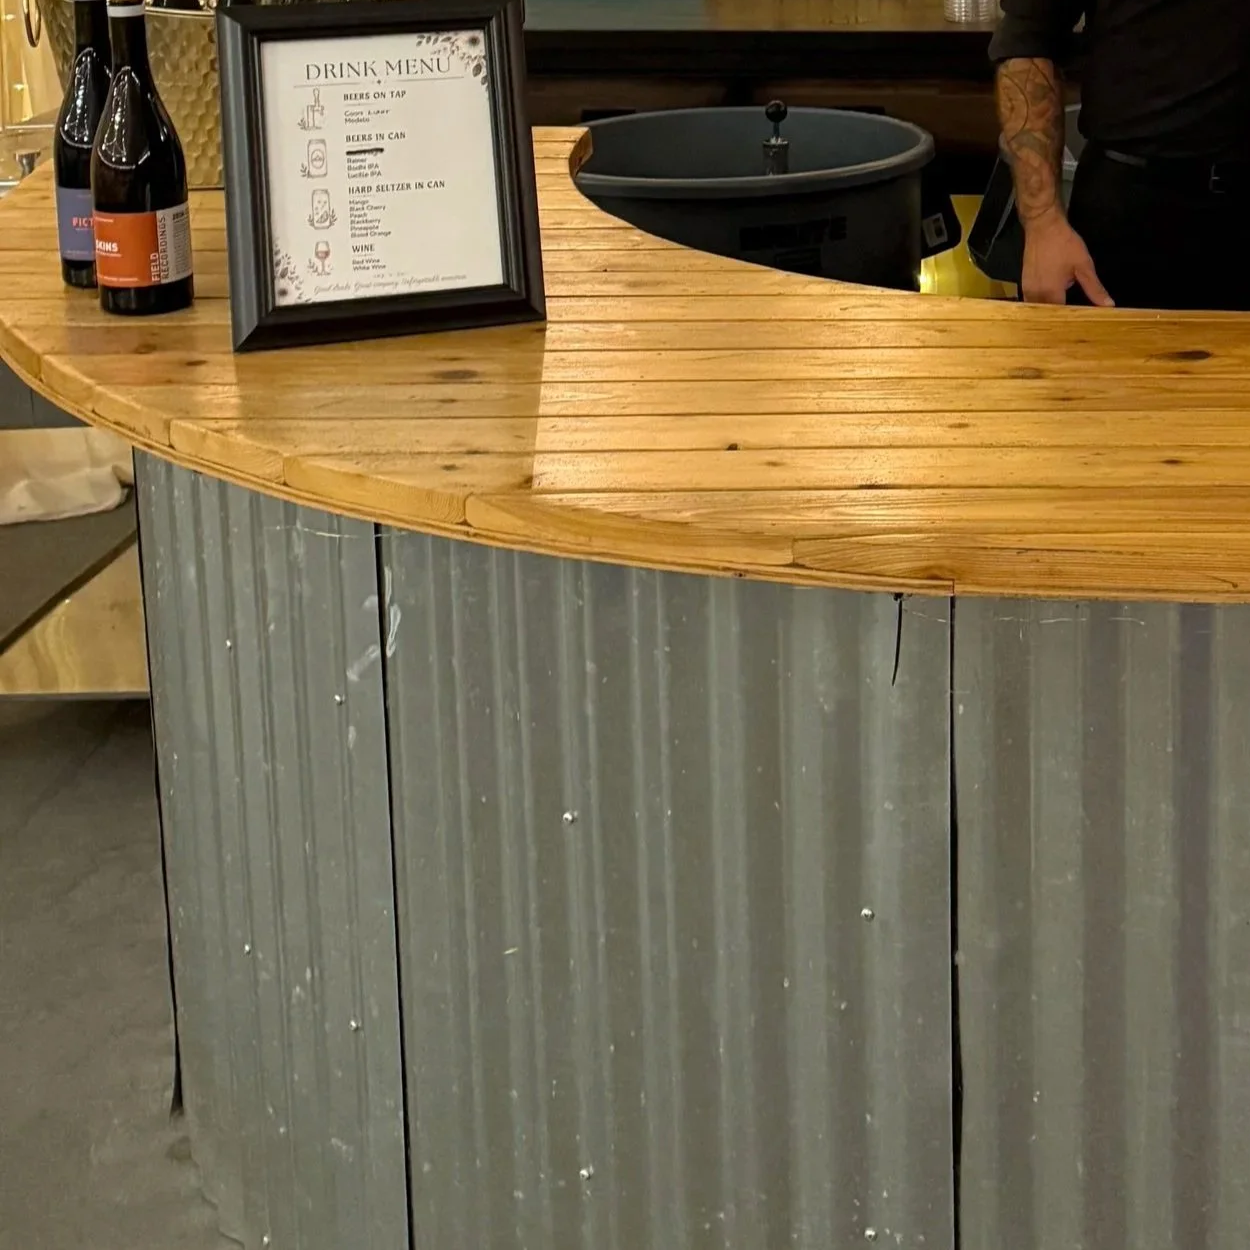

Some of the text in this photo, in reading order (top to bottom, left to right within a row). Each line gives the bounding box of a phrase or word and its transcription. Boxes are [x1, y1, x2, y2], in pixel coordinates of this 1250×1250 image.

[306, 55, 451, 80] DRINK MENU
[343, 90, 407, 101] BEERS ON TAP
[345, 132, 406, 142] BEERS IN CAN
[348, 180, 445, 195] HARD SELTZER IN CAN
[158, 216, 169, 280] RECORDINGS
[352, 244, 375, 253] WINE
[150, 252, 160, 282] FIELD
